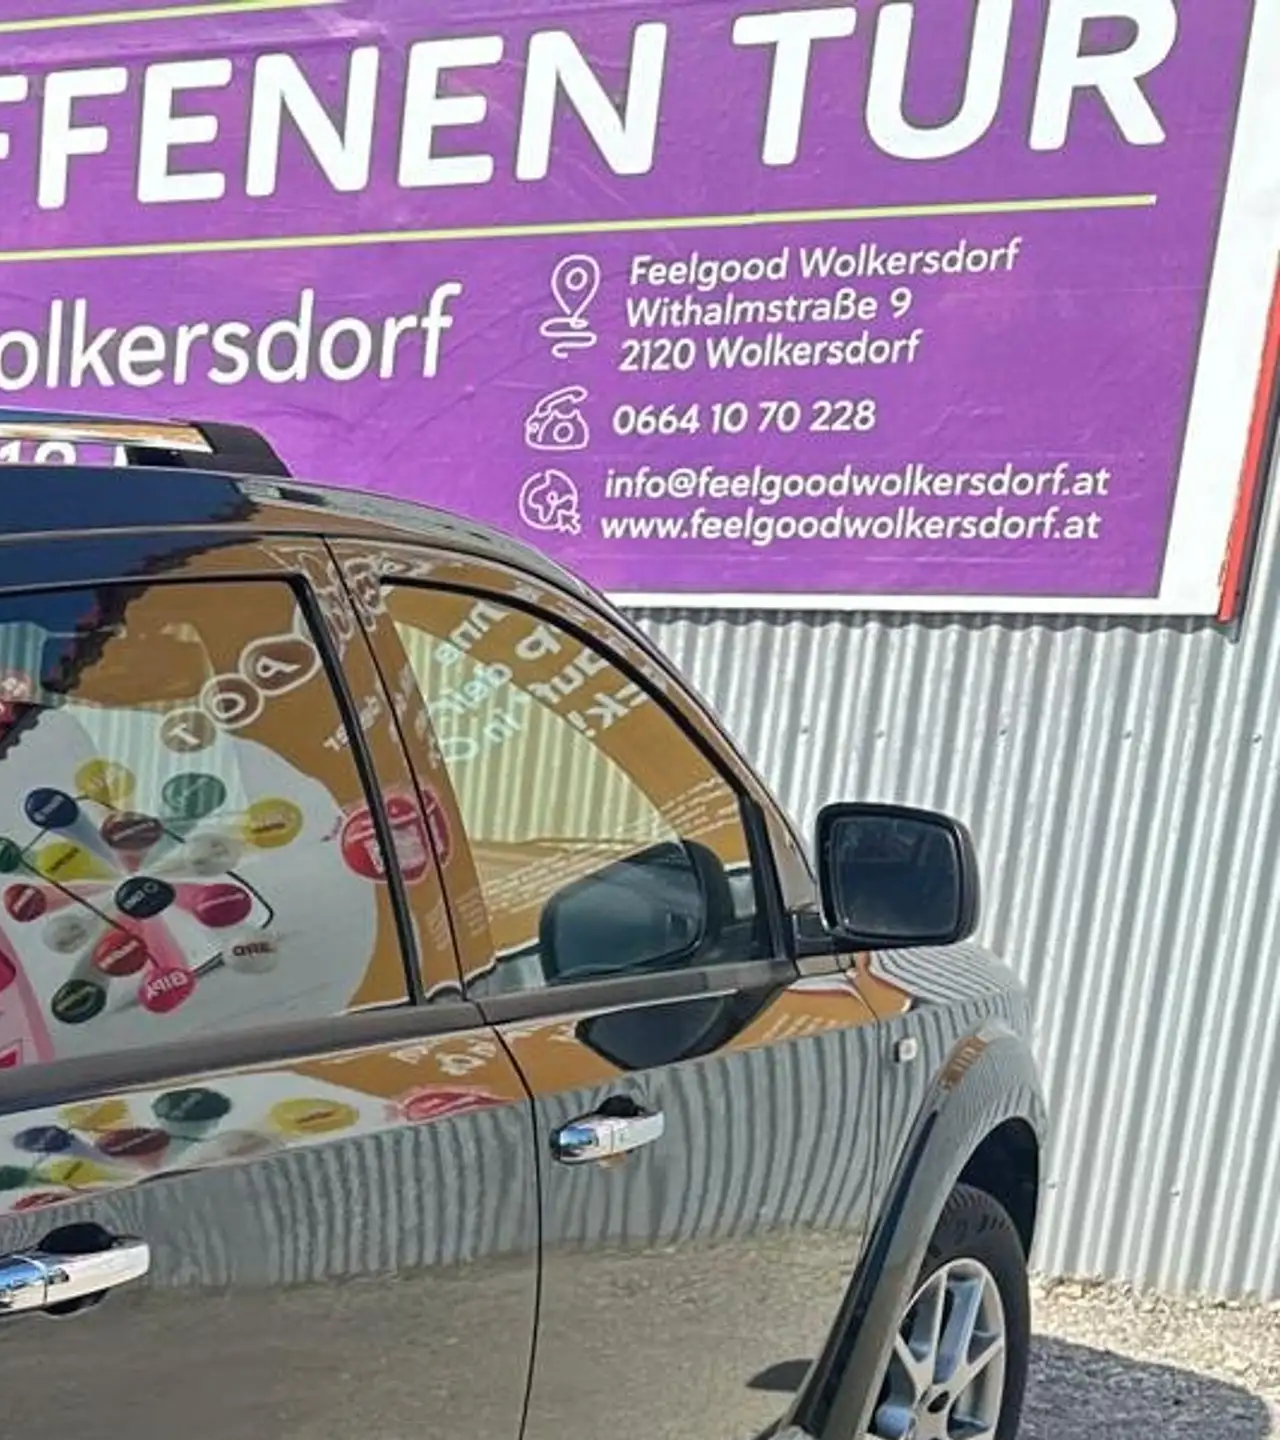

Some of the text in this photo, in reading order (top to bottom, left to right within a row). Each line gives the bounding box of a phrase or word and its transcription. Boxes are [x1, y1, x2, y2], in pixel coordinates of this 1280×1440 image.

[629, 237, 1022, 291] Feelgood Wolkersdorf
[626, 288, 912, 328] Withalmstraße 9
[619, 329, 924, 371] 2120 Wolkersdorf
[613, 399, 877, 436] 0664 10 70 228
[605, 462, 1111, 505] info@feelgoodwolkersdorf.at
[601, 505, 1101, 546] www.feelgoodwolkersdorf.at
